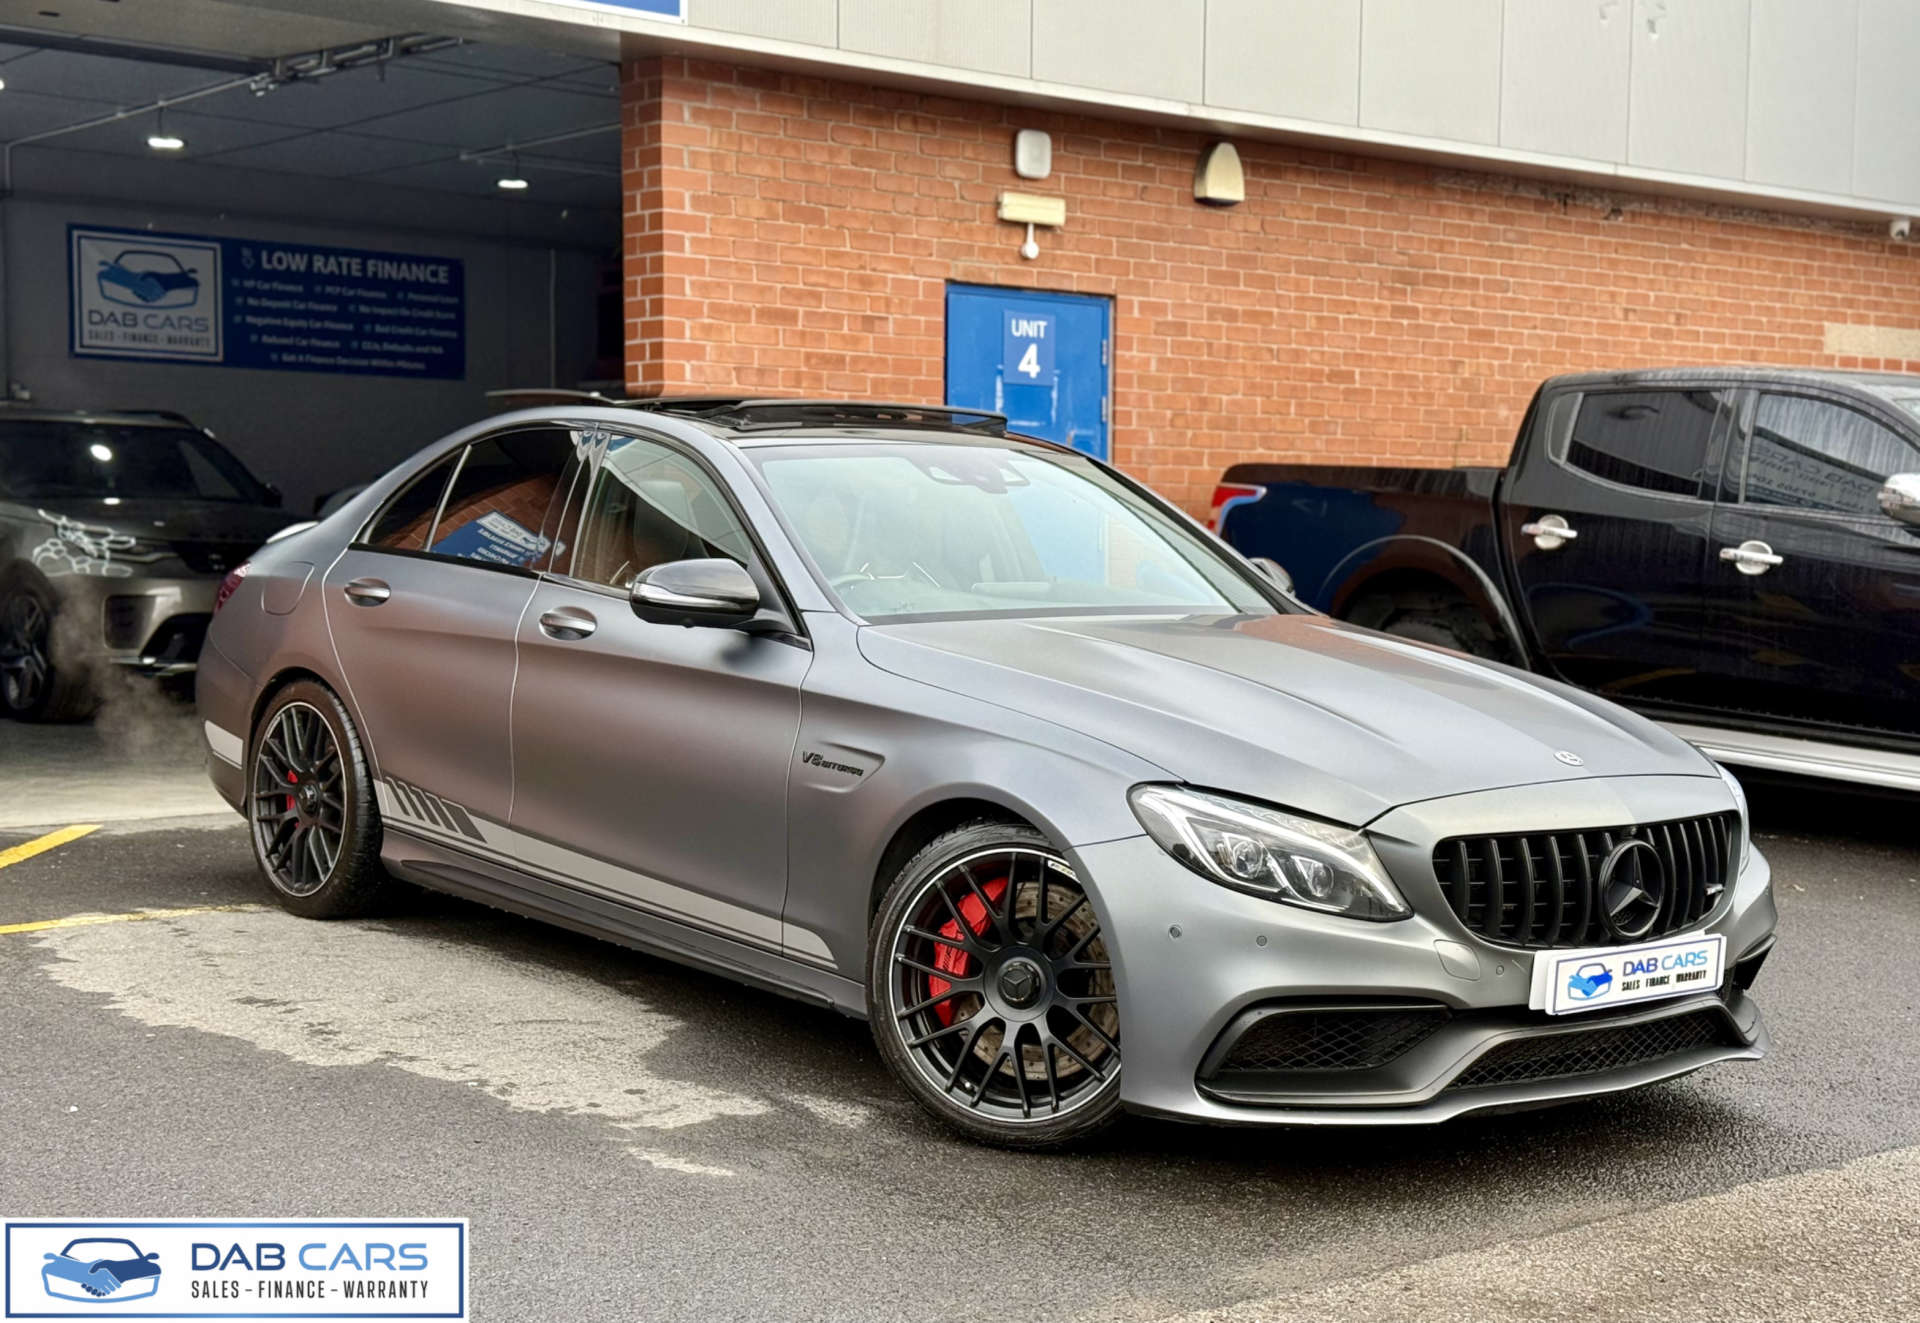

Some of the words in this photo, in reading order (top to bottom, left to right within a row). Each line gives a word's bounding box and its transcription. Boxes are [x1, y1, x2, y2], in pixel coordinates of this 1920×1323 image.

[261, 249, 308, 271] LOW
[312, 254, 363, 279] RATE
[366, 258, 449, 285] FINANCE
[88, 309, 138, 328] DAB
[143, 313, 209, 333] CARS
[1011, 318, 1048, 339] UNIT
[1017, 343, 1041, 379] 4
[1622, 957, 1659, 977] DAB
[1661, 950, 1708, 971] CARS
[1621, 978, 1640, 992] SALES
[1645, 974, 1670, 988] FINANCE
[1676, 969, 1707, 983] WARRANTY
